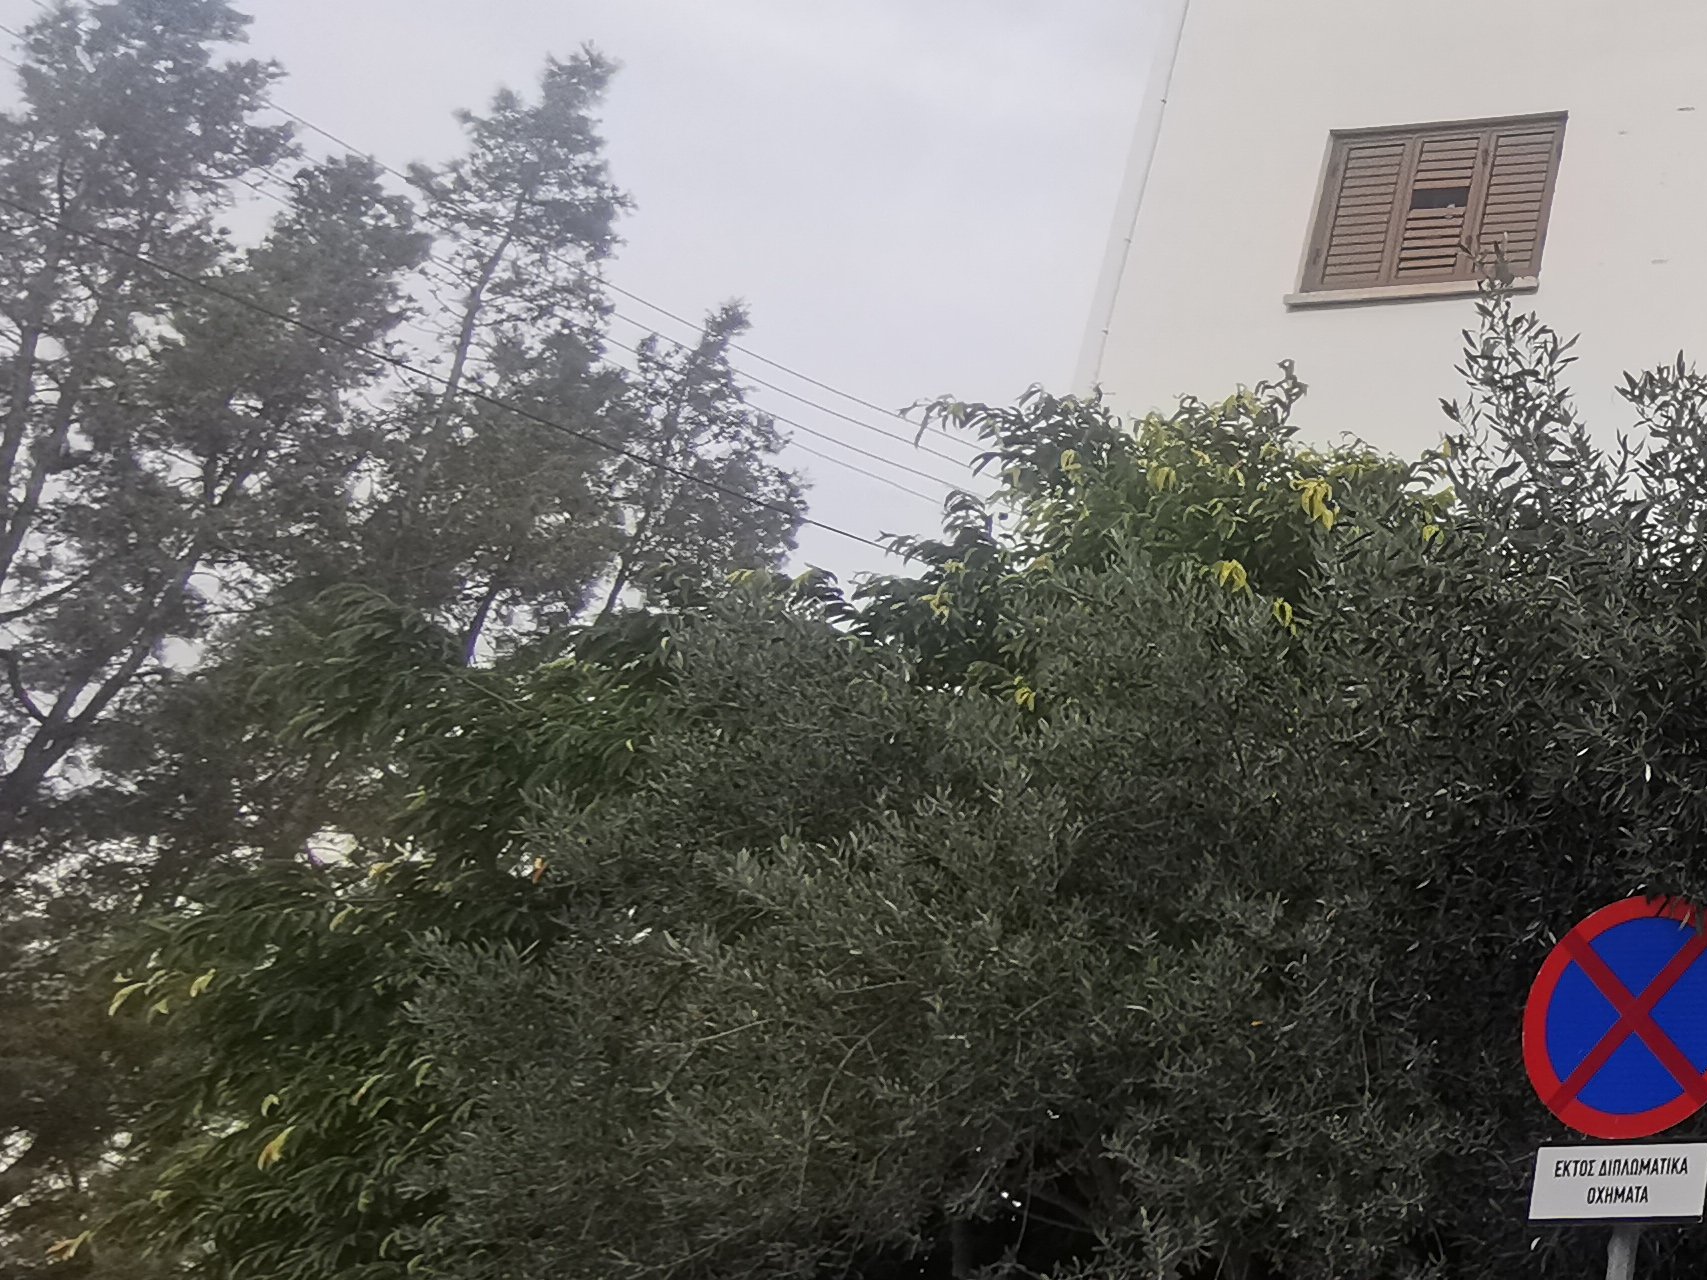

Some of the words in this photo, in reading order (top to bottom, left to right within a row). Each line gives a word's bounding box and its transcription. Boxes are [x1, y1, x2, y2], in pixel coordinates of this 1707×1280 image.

[1554, 1159, 1596, 1178] ΕΚΤΟΣ
[1598, 1156, 1689, 1177] ΔΙΠΛΩΜΑΤΙΚΑ
[1586, 1185, 1649, 1205] ΟΧΗΜΑΤΑ
